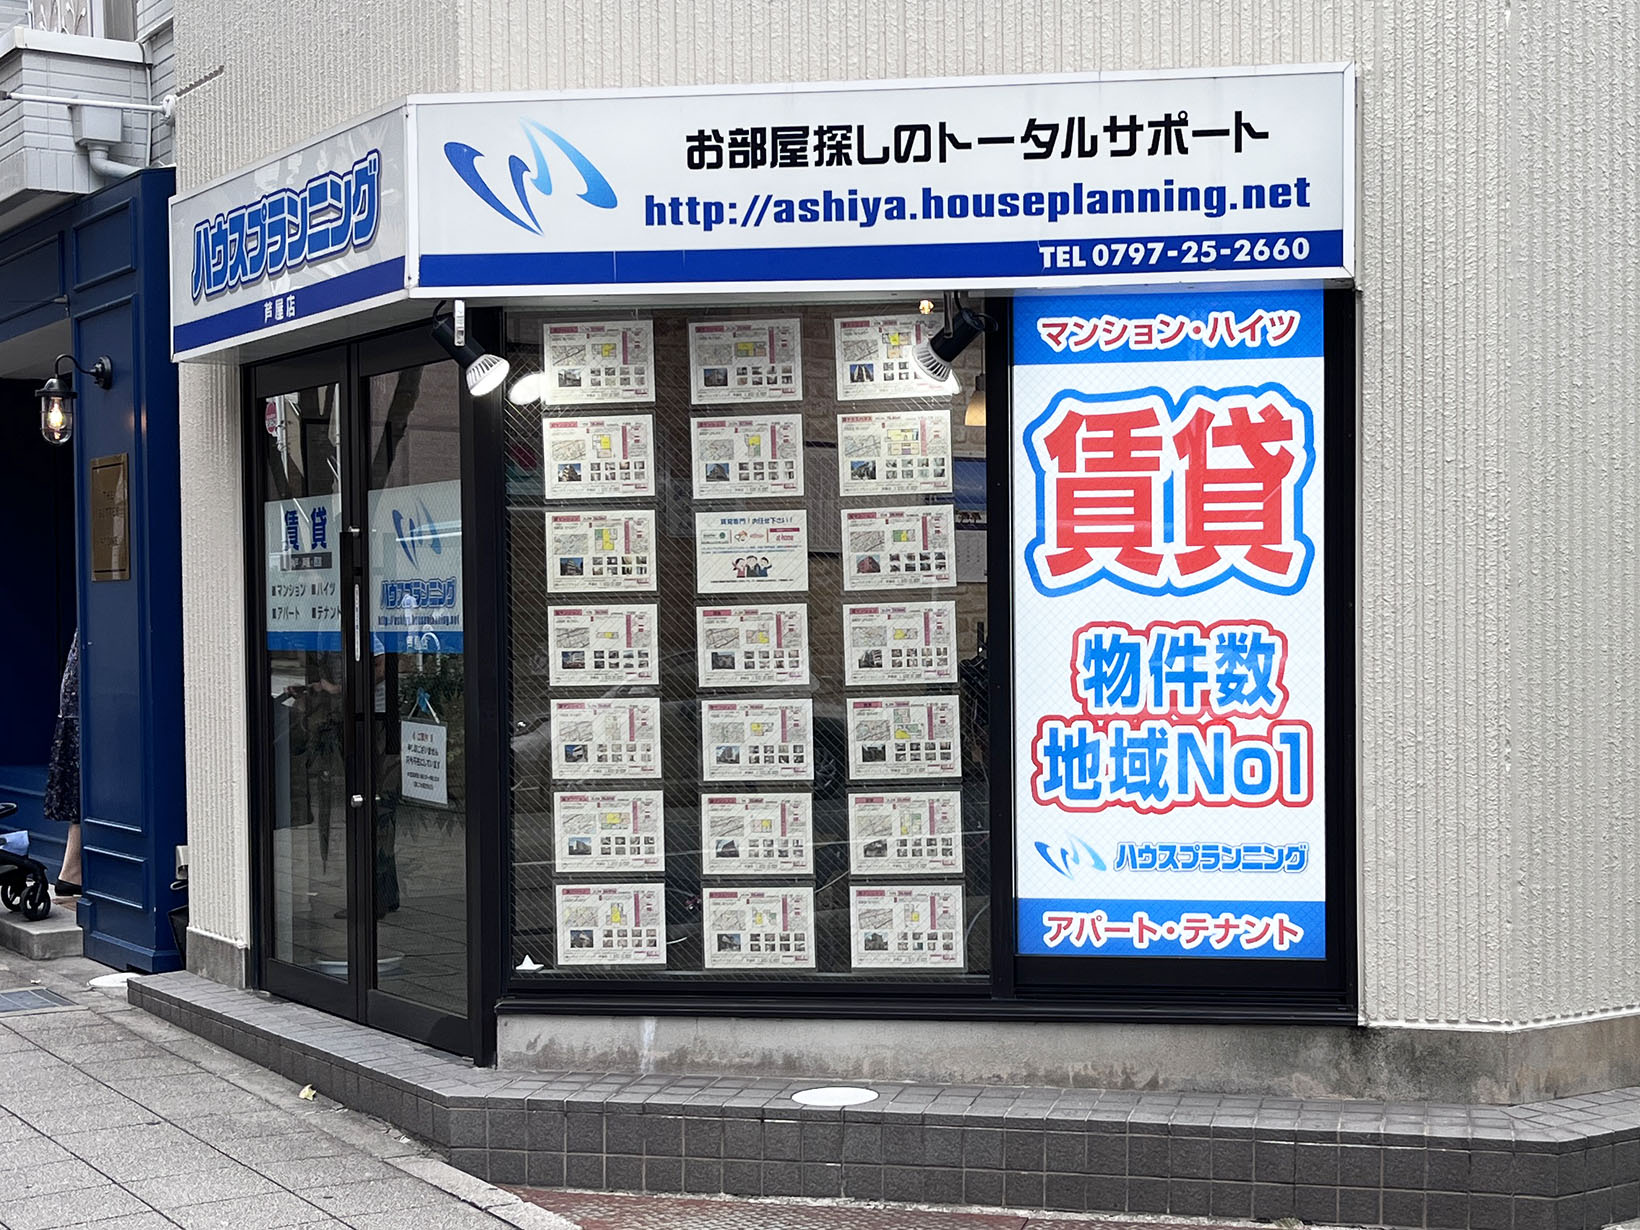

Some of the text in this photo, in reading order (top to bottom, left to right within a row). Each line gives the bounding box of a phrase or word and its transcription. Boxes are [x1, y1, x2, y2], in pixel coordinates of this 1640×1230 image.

[685, 111, 1270, 170] お部屋探しのトータルサポート
[192, 148, 382, 302] ハウスプランニング
[644, 177, 1311, 231] http://ashiya.houseplanning.net
[1039, 237, 1311, 269] TEL 0797-25-2660
[263, 294, 296, 322] 芦屋店
[1040, 312, 1298, 349] マンション・ハイツ
[1043, 402, 1296, 577] 賃貸
[284, 506, 328, 550] 賃貸
[1082, 631, 1277, 708] 物件数
[1042, 726, 1301, 801] 地域No1
[1115, 843, 1308, 871] ハウスプランニング
[1046, 914, 1299, 946] アパート・テナント
